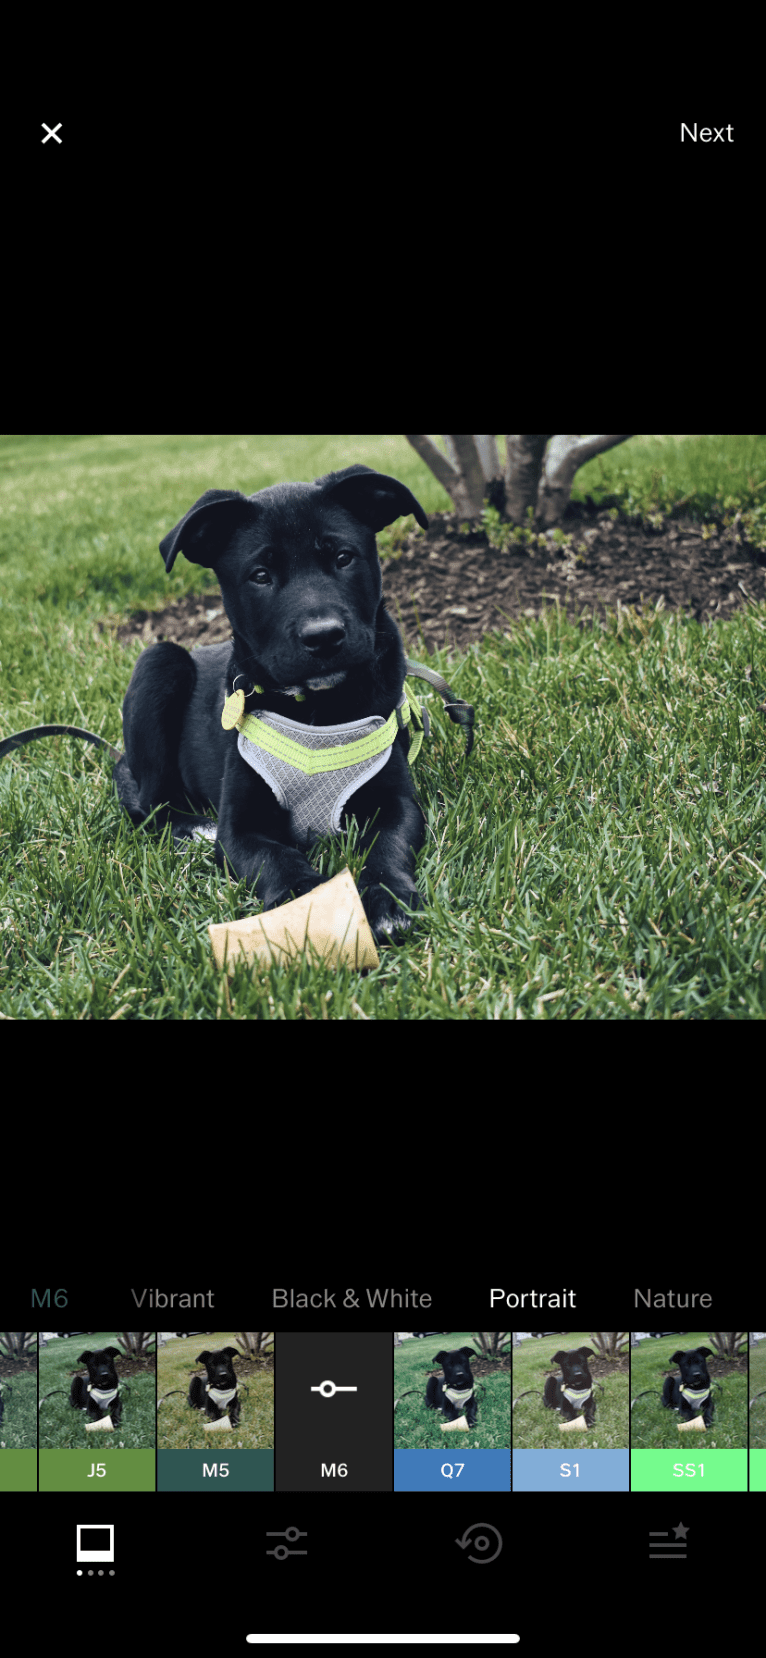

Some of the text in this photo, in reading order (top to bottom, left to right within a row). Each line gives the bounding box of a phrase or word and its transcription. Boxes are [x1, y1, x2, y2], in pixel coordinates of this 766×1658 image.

[681, 123, 734, 142] Next
[30, 1288, 69, 1309] M6
[130, 1288, 215, 1309] Vibrant
[272, 1288, 433, 1309] Black & White
[489, 1288, 577, 1309] Portrait
[634, 1288, 713, 1309] Nature
[87, 1463, 107, 1478] J5
[202, 1463, 230, 1478] M5
[321, 1463, 349, 1478] M6
[440, 1463, 465, 1479] Q7
[559, 1463, 580, 1478] S1
[672, 1463, 705, 1478] SS1
